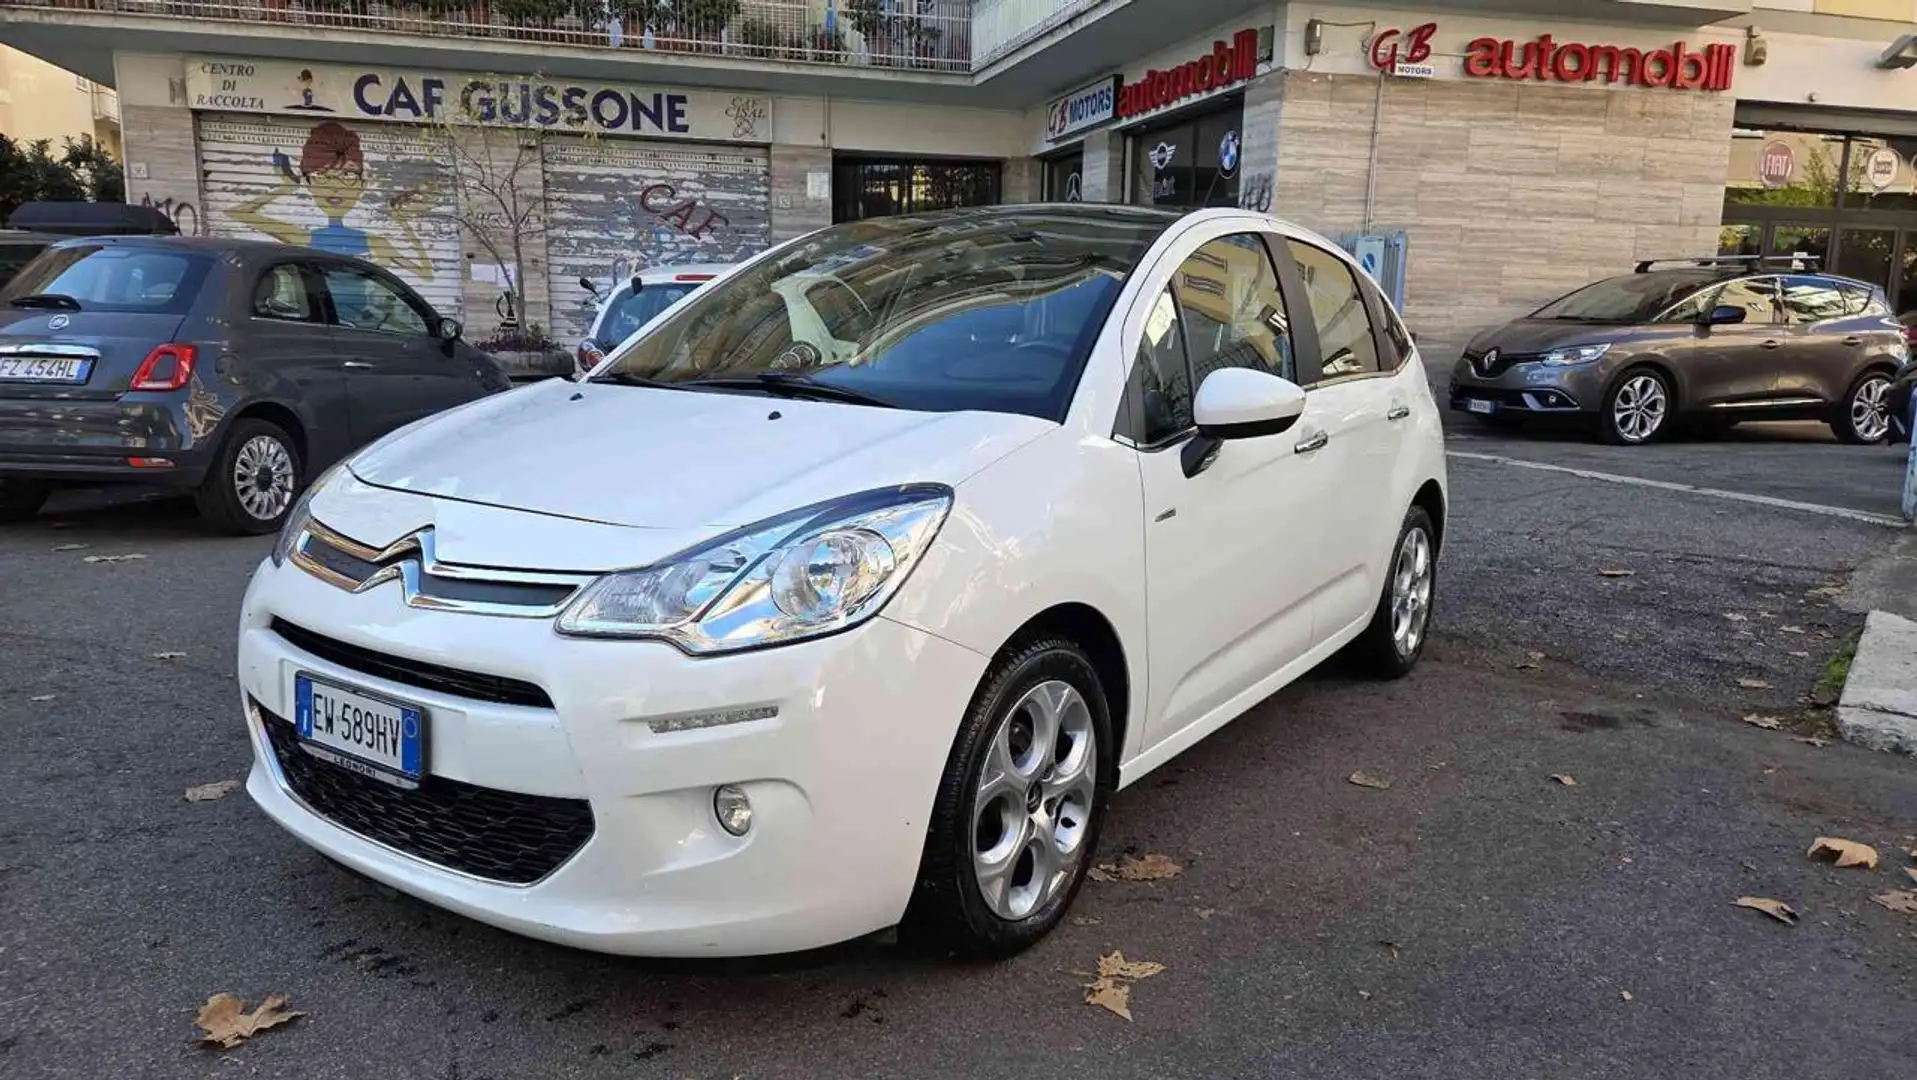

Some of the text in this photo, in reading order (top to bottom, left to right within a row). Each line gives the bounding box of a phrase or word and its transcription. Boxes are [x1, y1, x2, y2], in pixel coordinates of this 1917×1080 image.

[201, 62, 255, 77] CENTRO
[1397, 66, 1432, 75] MOTORS
[222, 80, 236, 92] DI
[196, 94, 264, 109] RACCOLTA
[353, 73, 690, 133] CAF GUSSONE
[1069, 86, 1112, 124] MOTORS
[1765, 153, 1789, 177] FIAT
[640, 184, 729, 240] CAF
[24, 359, 77, 378] 454HL
[313, 692, 400, 757] EW 589HV
